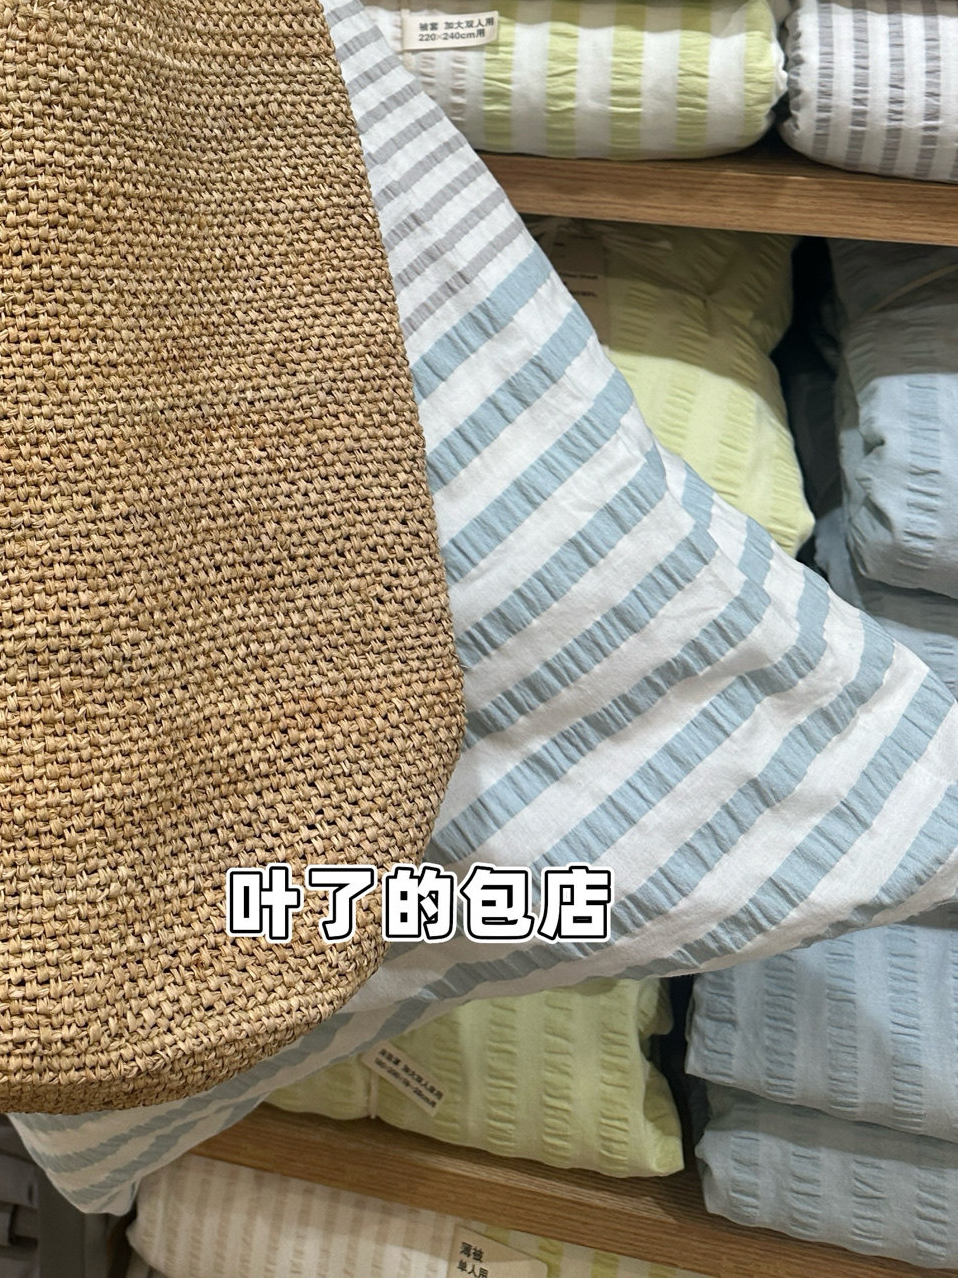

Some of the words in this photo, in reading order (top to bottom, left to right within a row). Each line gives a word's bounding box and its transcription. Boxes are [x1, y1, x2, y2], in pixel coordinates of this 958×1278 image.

[419, 22, 439, 32] 被套
[444, 17, 495, 30] 加大双人用
[418, 28, 487, 42] 220×240cm用
